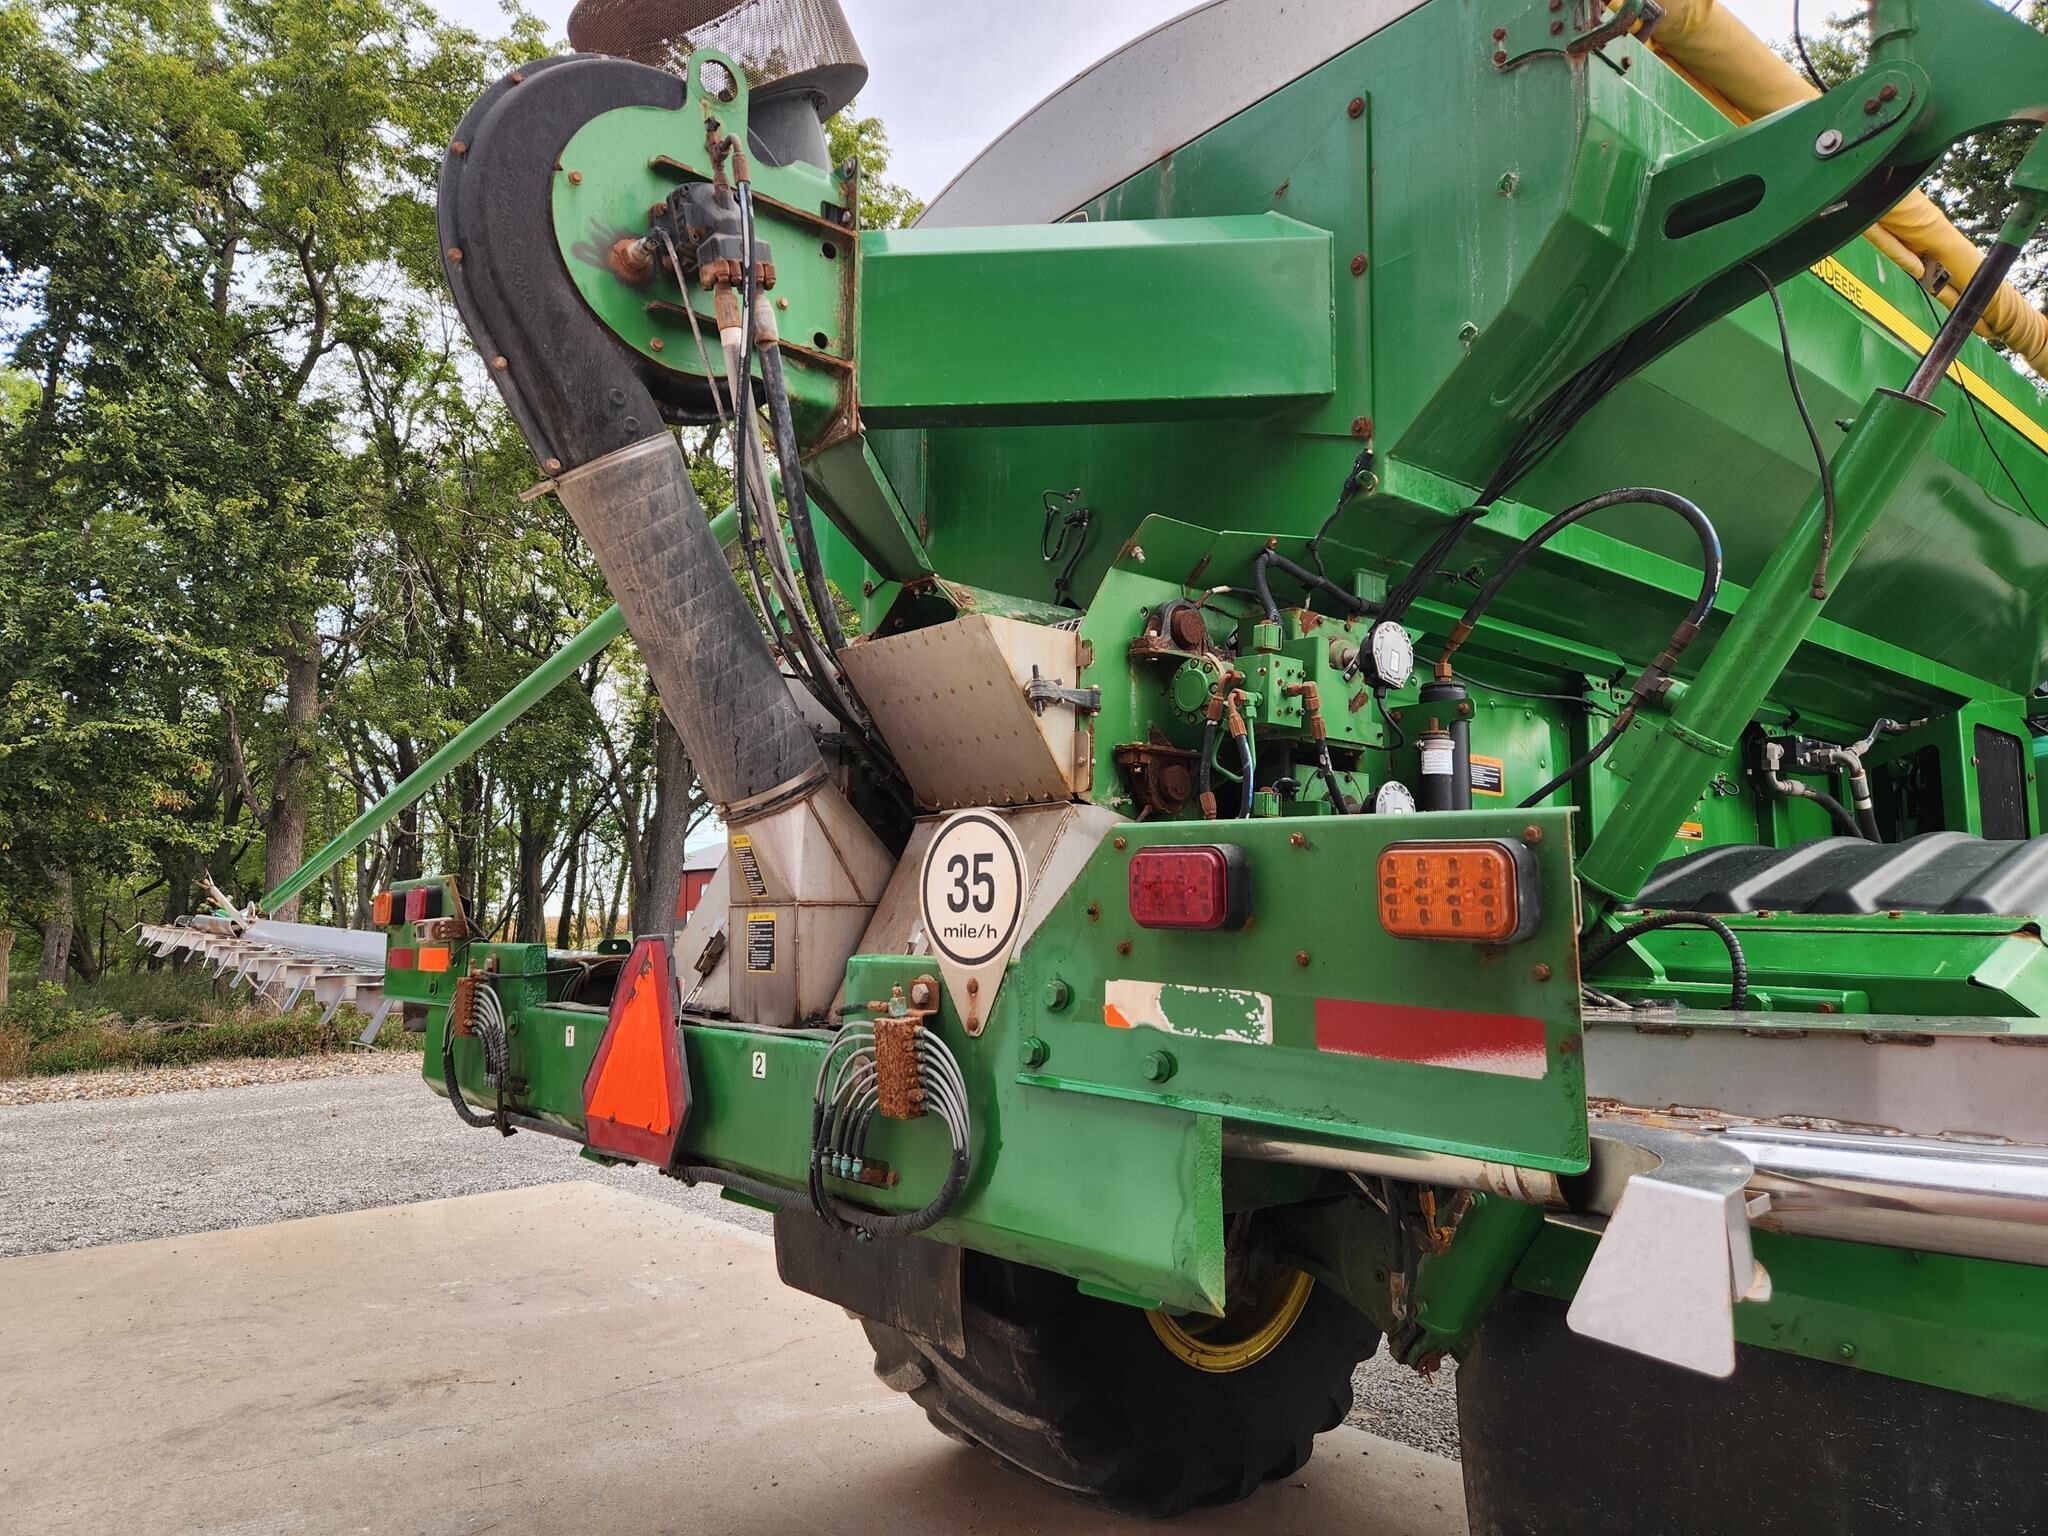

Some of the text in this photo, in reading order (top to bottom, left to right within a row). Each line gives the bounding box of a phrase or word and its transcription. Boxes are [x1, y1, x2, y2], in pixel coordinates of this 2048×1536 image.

[1825, 258, 1863, 306] DEERE
[947, 853, 995, 913] 35
[944, 923, 997, 939] mile/h
[755, 1054, 763, 1075] 2
